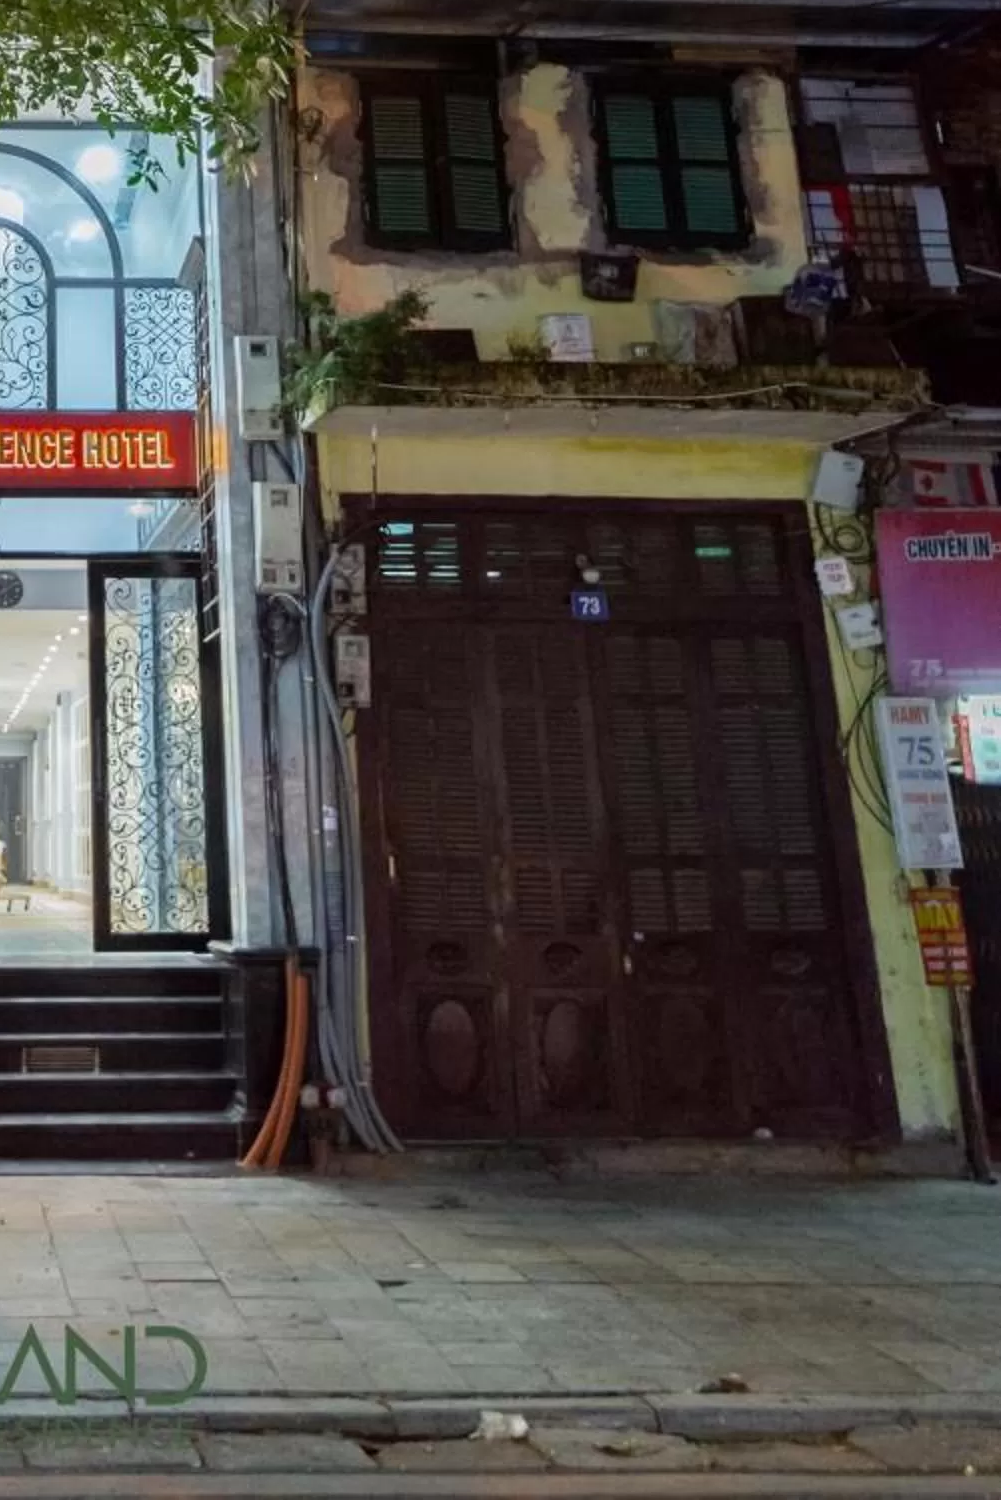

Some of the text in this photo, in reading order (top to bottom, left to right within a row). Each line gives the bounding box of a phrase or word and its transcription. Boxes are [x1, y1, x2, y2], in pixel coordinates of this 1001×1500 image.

[82, 428, 175, 469] HOTEL
[578, 596, 601, 615] 73
[898, 736, 936, 766] 75
